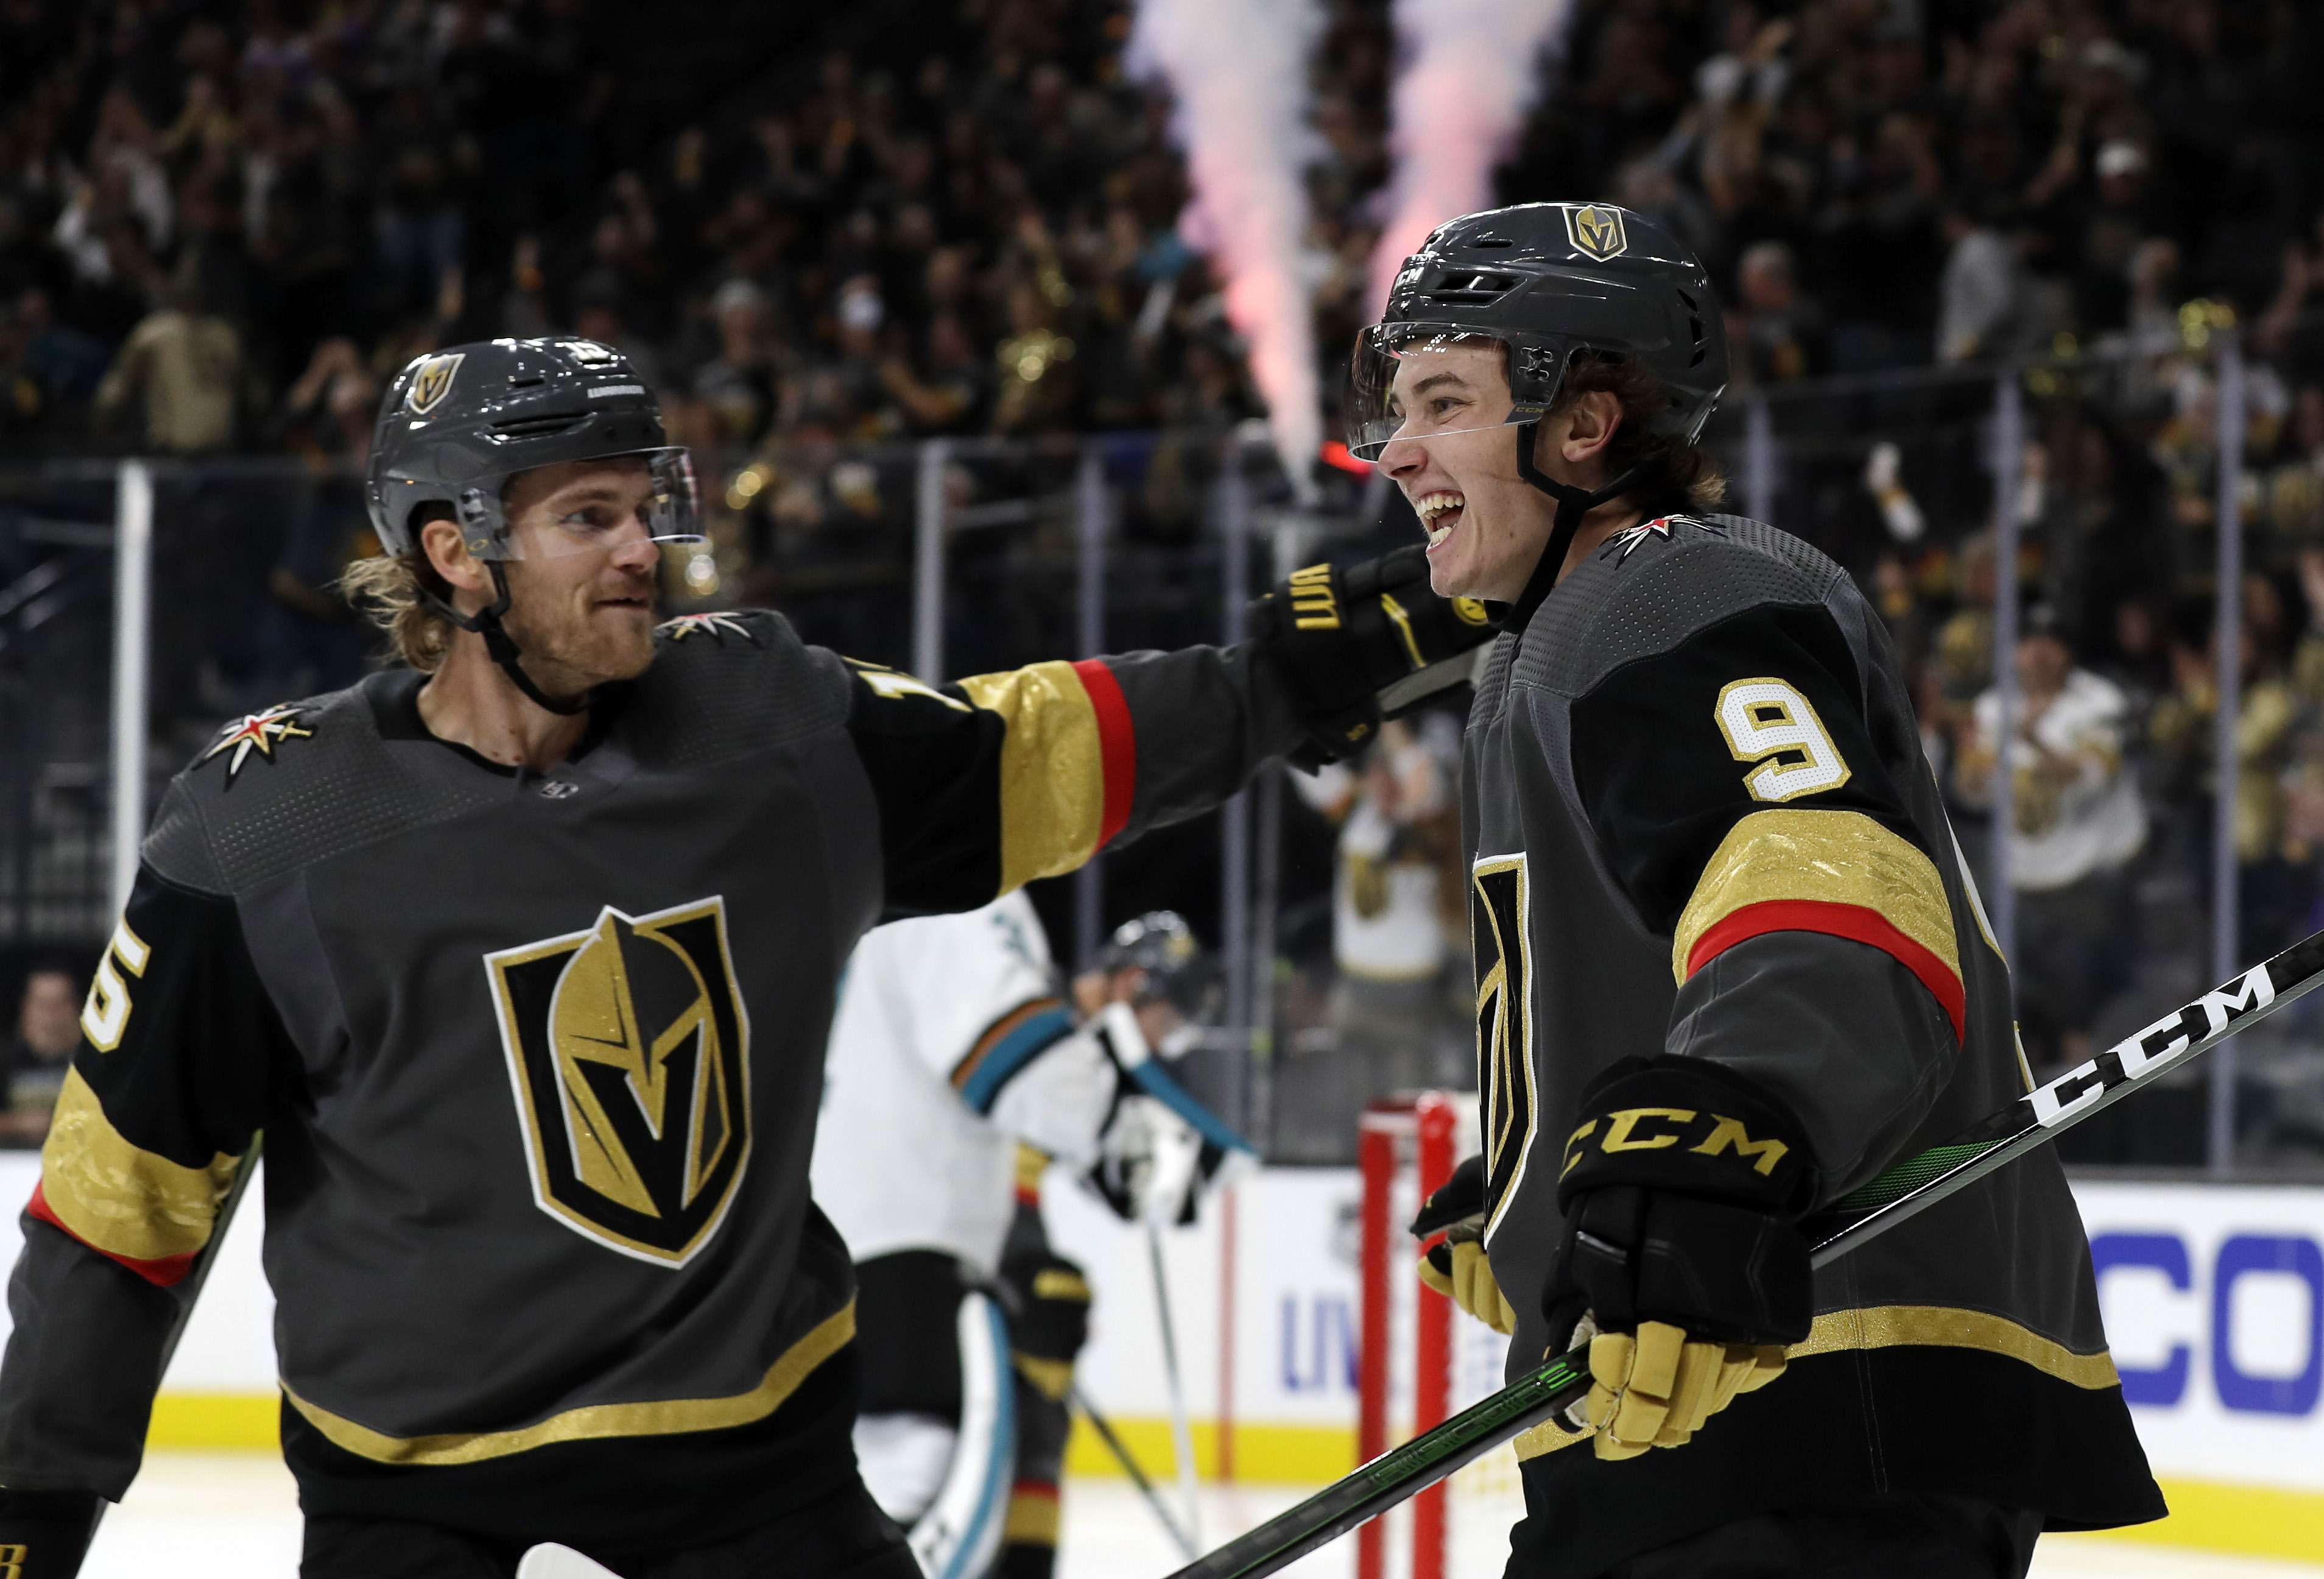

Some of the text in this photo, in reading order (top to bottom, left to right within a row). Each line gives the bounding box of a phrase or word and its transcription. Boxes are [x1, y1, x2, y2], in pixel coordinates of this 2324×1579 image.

[1713, 677, 1852, 803] 9
[2018, 963, 2276, 1129] CCM
[1558, 1107, 1789, 1183] CCM
